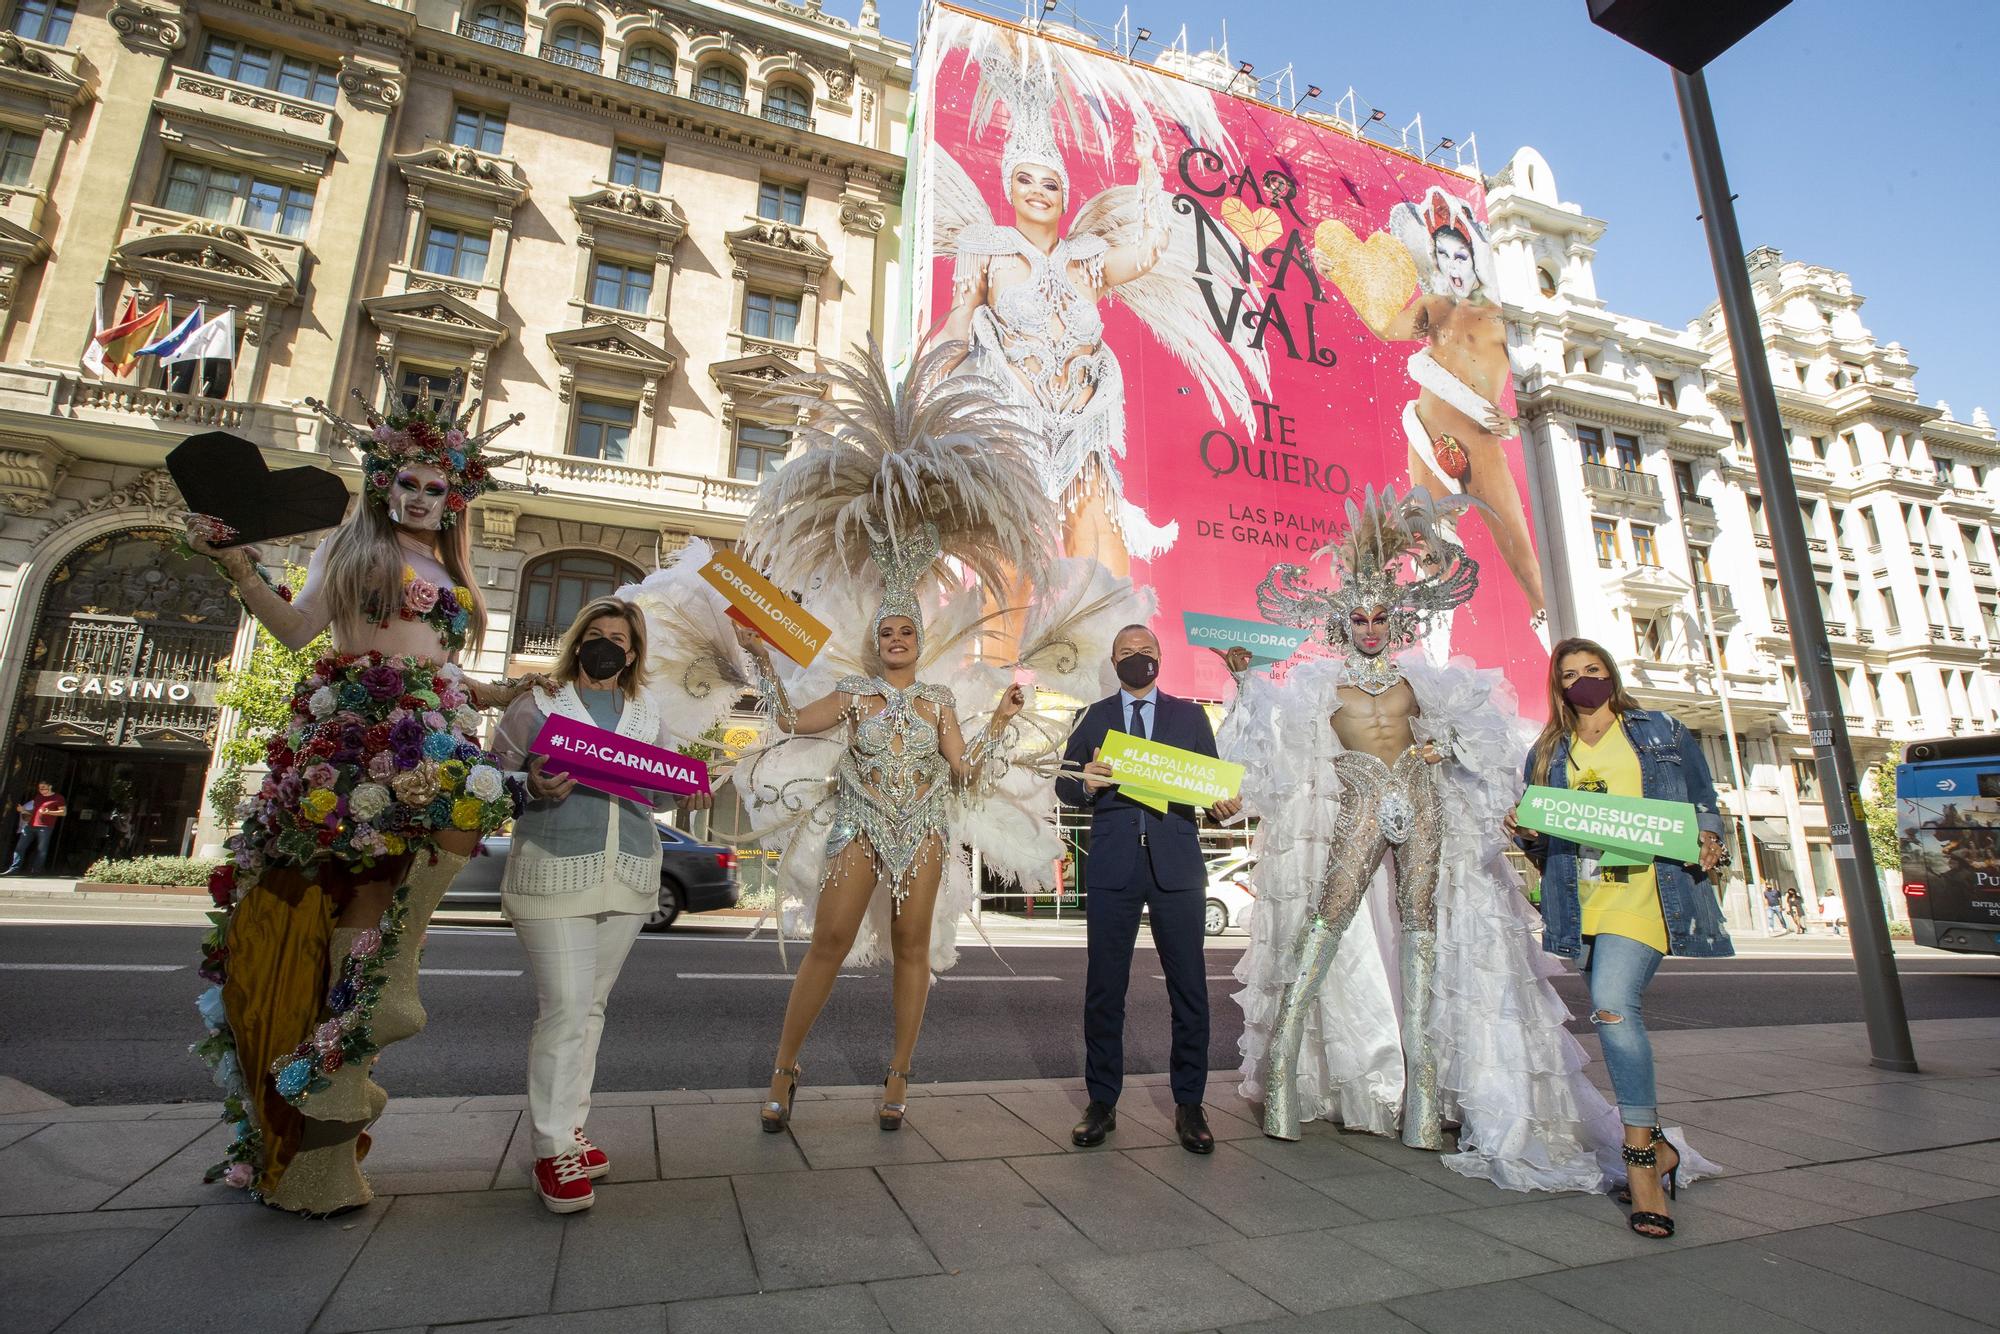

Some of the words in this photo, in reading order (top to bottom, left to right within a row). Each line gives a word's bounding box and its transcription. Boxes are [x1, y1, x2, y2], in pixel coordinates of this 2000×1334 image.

[1252, 400, 1297, 447] TE
[1200, 430, 1350, 495] QUIERO
[1229, 503, 1267, 525] LAS
[1197, 520, 1225, 539] DE
[1232, 526, 1289, 549] GRAN
[712, 563, 818, 651] #ORGULLOREINA
[1190, 627, 1298, 648] #ORGULLODRAG
[57, 676, 190, 700] CASINO
[550, 734, 700, 785] #LPACARNAVAL
[1123, 748, 1216, 781] #LASPALMAS
[1531, 797, 1685, 834] #DONDESUCEDE
[1545, 813, 1664, 847] ELCARNAVAL
